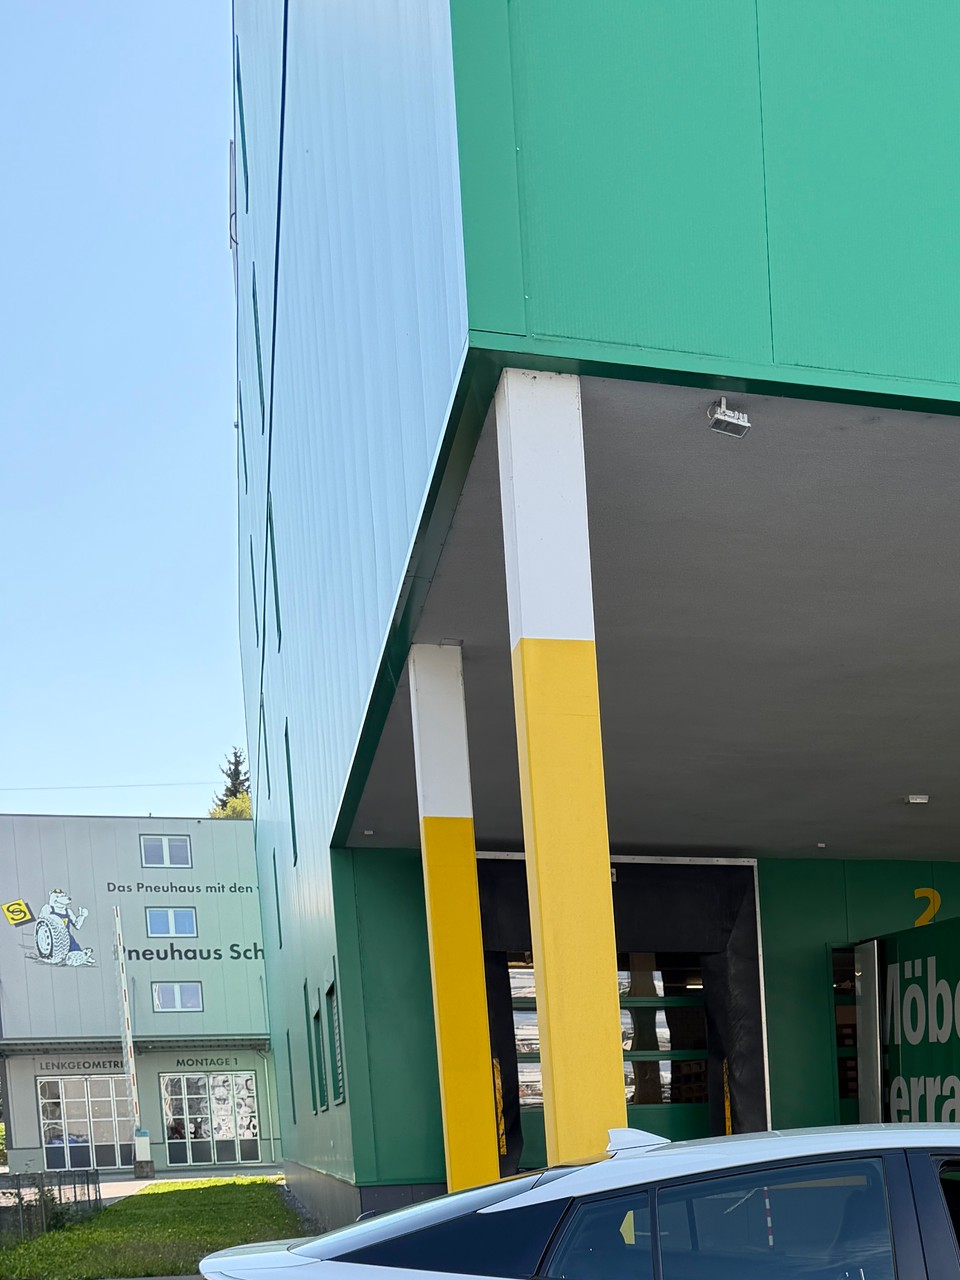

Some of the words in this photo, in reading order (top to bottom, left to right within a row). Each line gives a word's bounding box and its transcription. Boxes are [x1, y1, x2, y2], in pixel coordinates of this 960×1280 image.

[107, 882, 132, 893] Das
[137, 882, 202, 893] Pneuhaus
[205, 882, 226, 893] mit
[229, 882, 253, 893] den
[914, 887, 942, 928] 2
[176, 1058, 230, 1067] MONTAGE
[233, 1058, 239, 1066] 1
